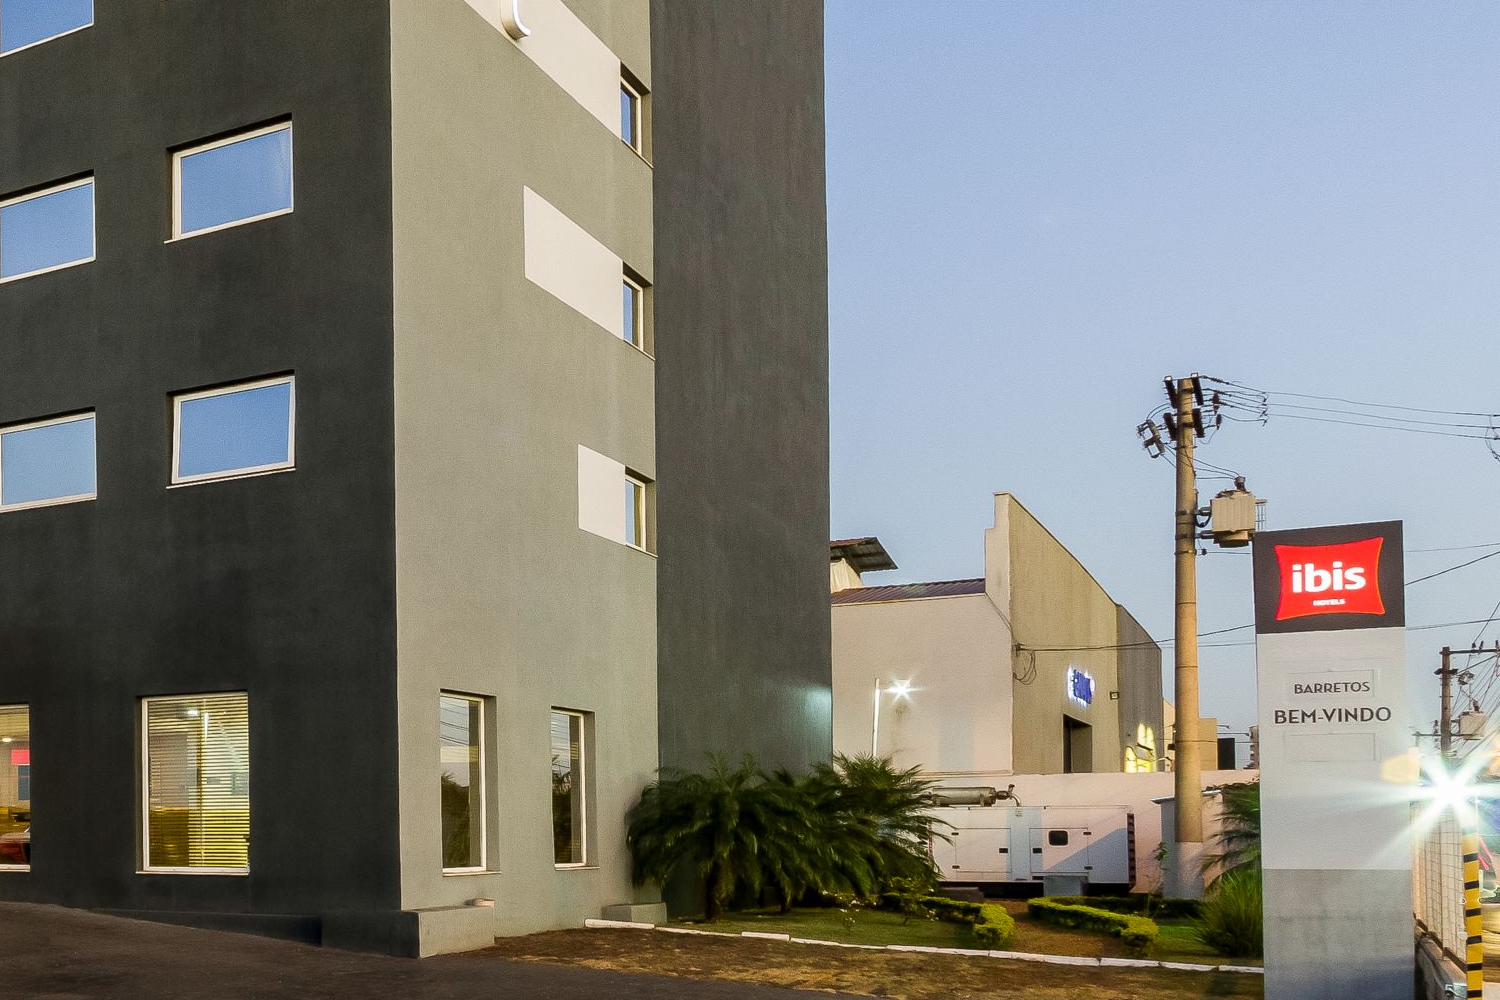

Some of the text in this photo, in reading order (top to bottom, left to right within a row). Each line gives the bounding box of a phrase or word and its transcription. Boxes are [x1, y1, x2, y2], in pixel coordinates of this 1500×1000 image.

[1292, 561, 1367, 593] ibis
[1294, 681, 1371, 695] BARRETOS
[1274, 706, 1392, 725] BEM-VINDO
